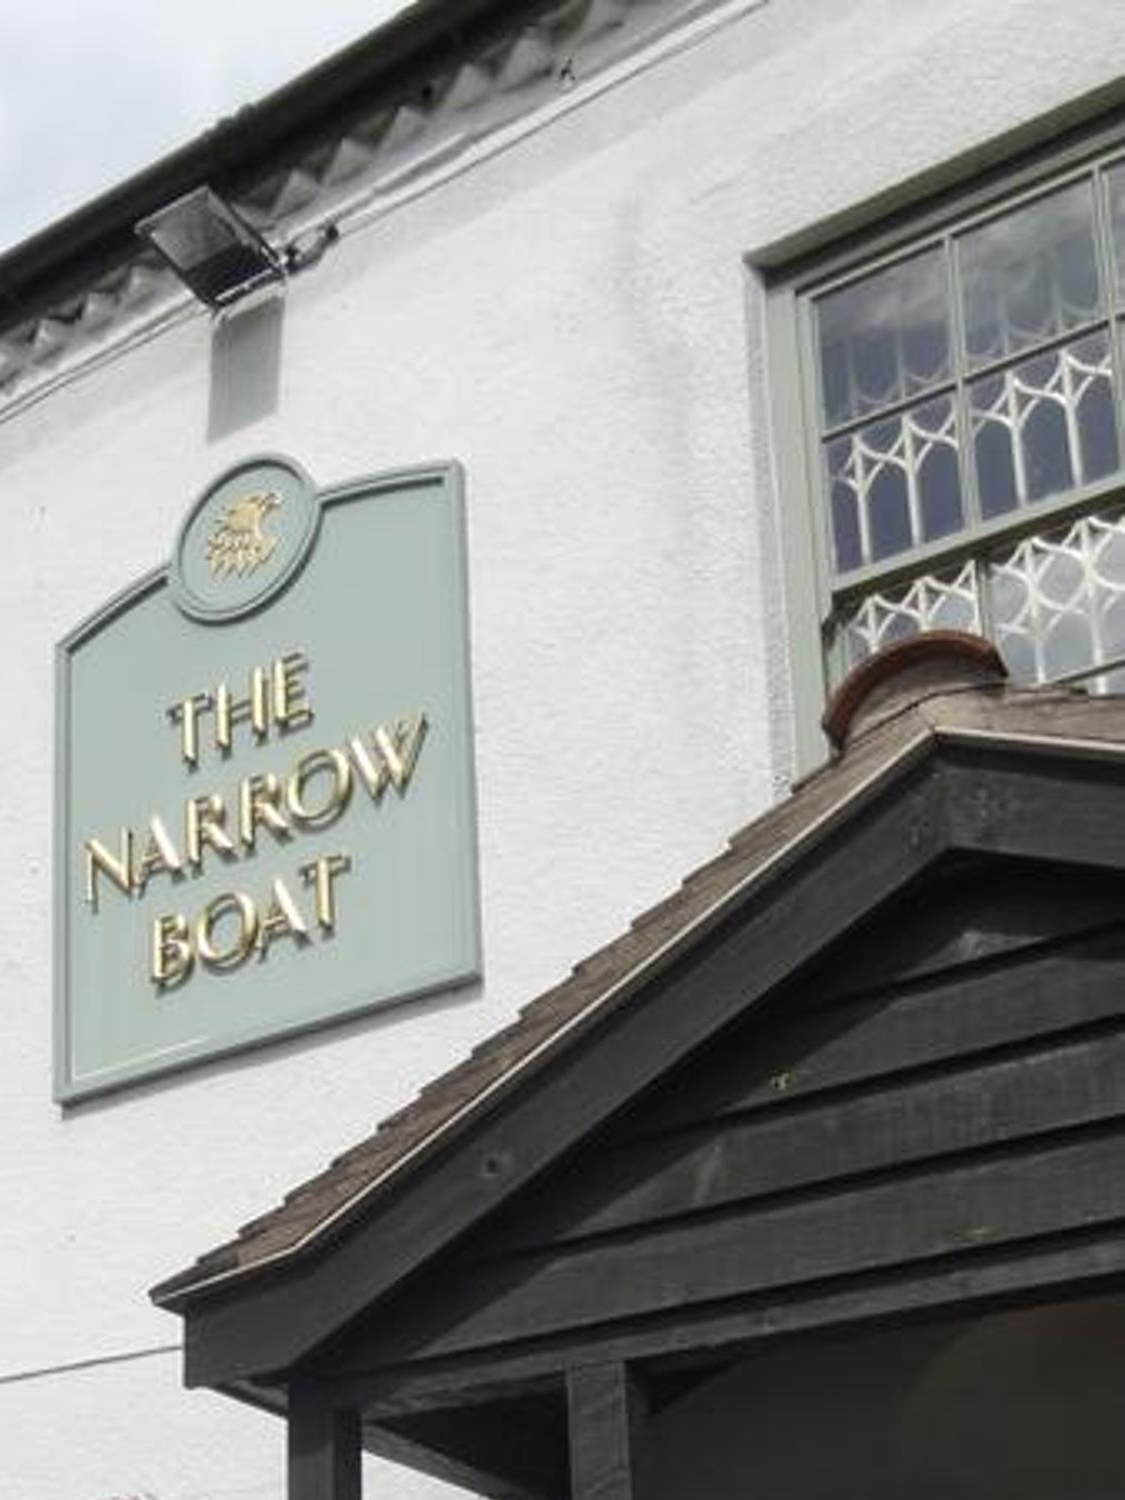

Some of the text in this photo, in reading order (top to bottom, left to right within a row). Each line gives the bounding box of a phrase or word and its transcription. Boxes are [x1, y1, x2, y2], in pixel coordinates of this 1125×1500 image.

[167, 653, 312, 768] THE
[84, 712, 429, 911] NARROW
[151, 855, 350, 993] BOAT
